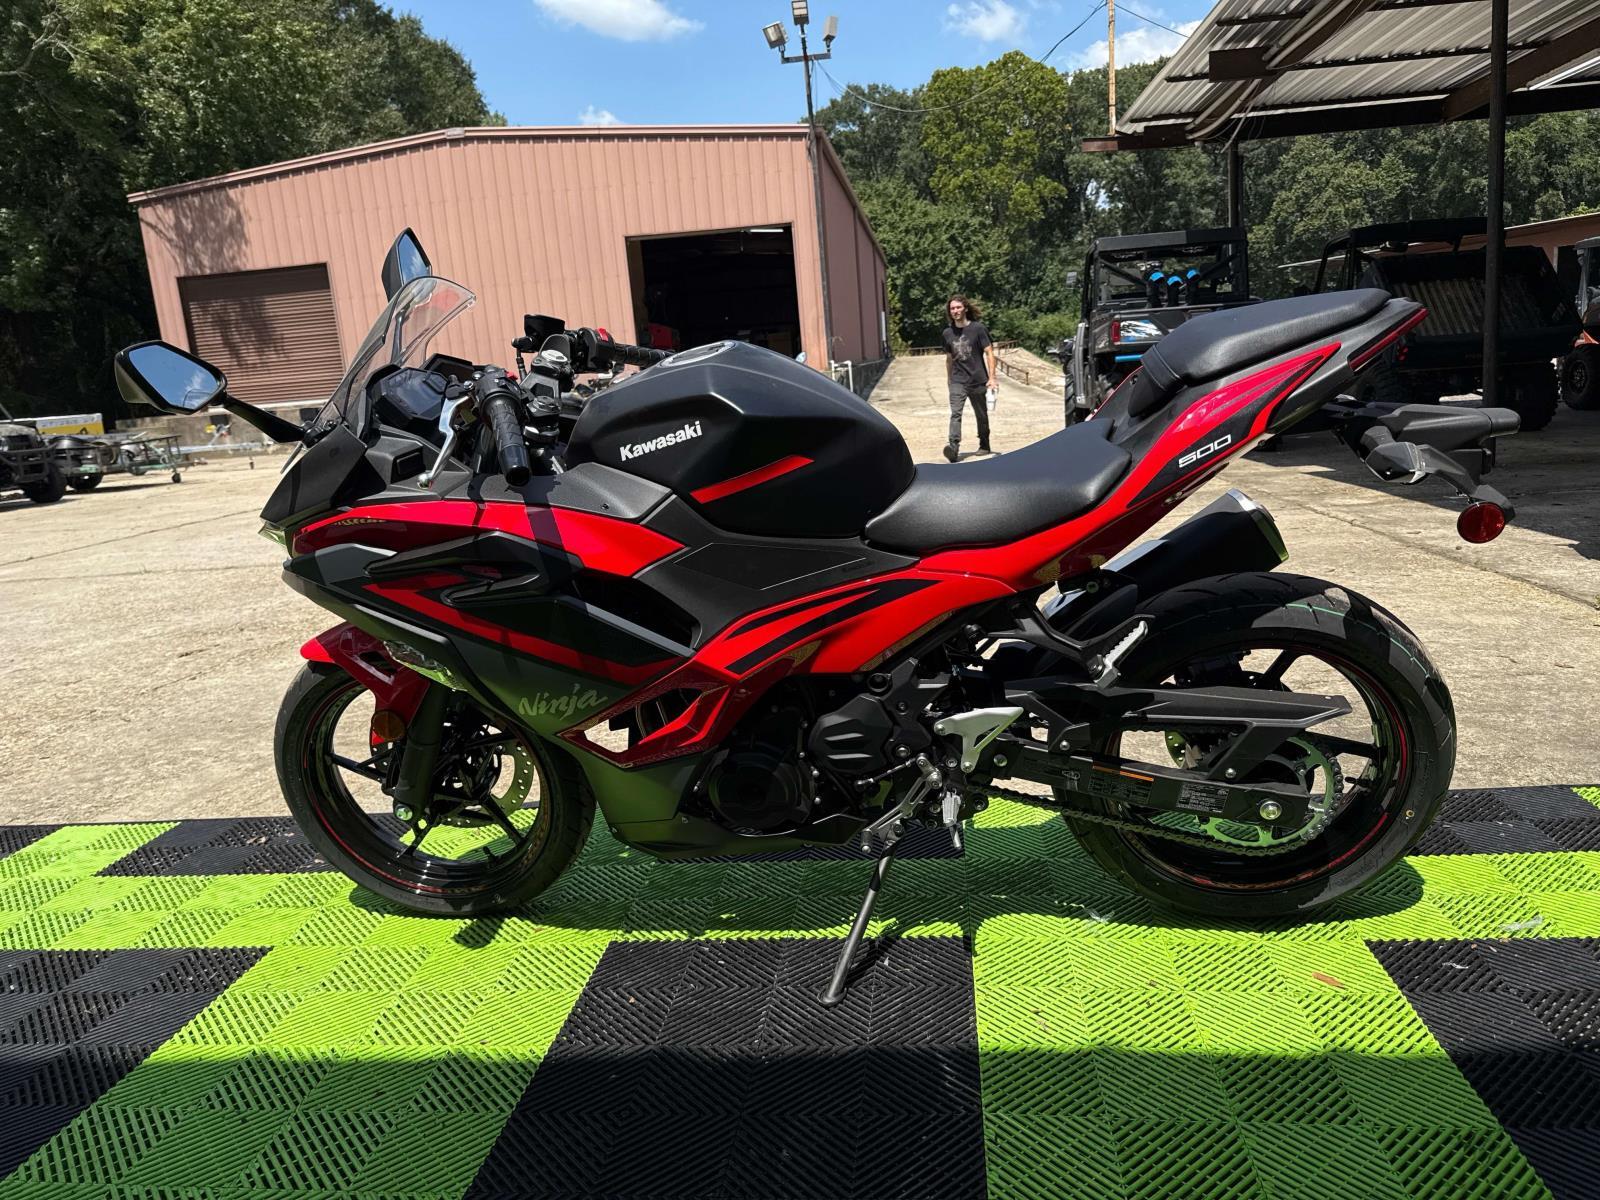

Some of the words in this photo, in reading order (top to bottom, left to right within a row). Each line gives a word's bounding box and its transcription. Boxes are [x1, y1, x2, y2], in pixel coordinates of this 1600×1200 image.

[620, 421, 702, 461] Kawasaki
[1179, 434, 1231, 468] 500
[519, 683, 608, 721] Ninja
